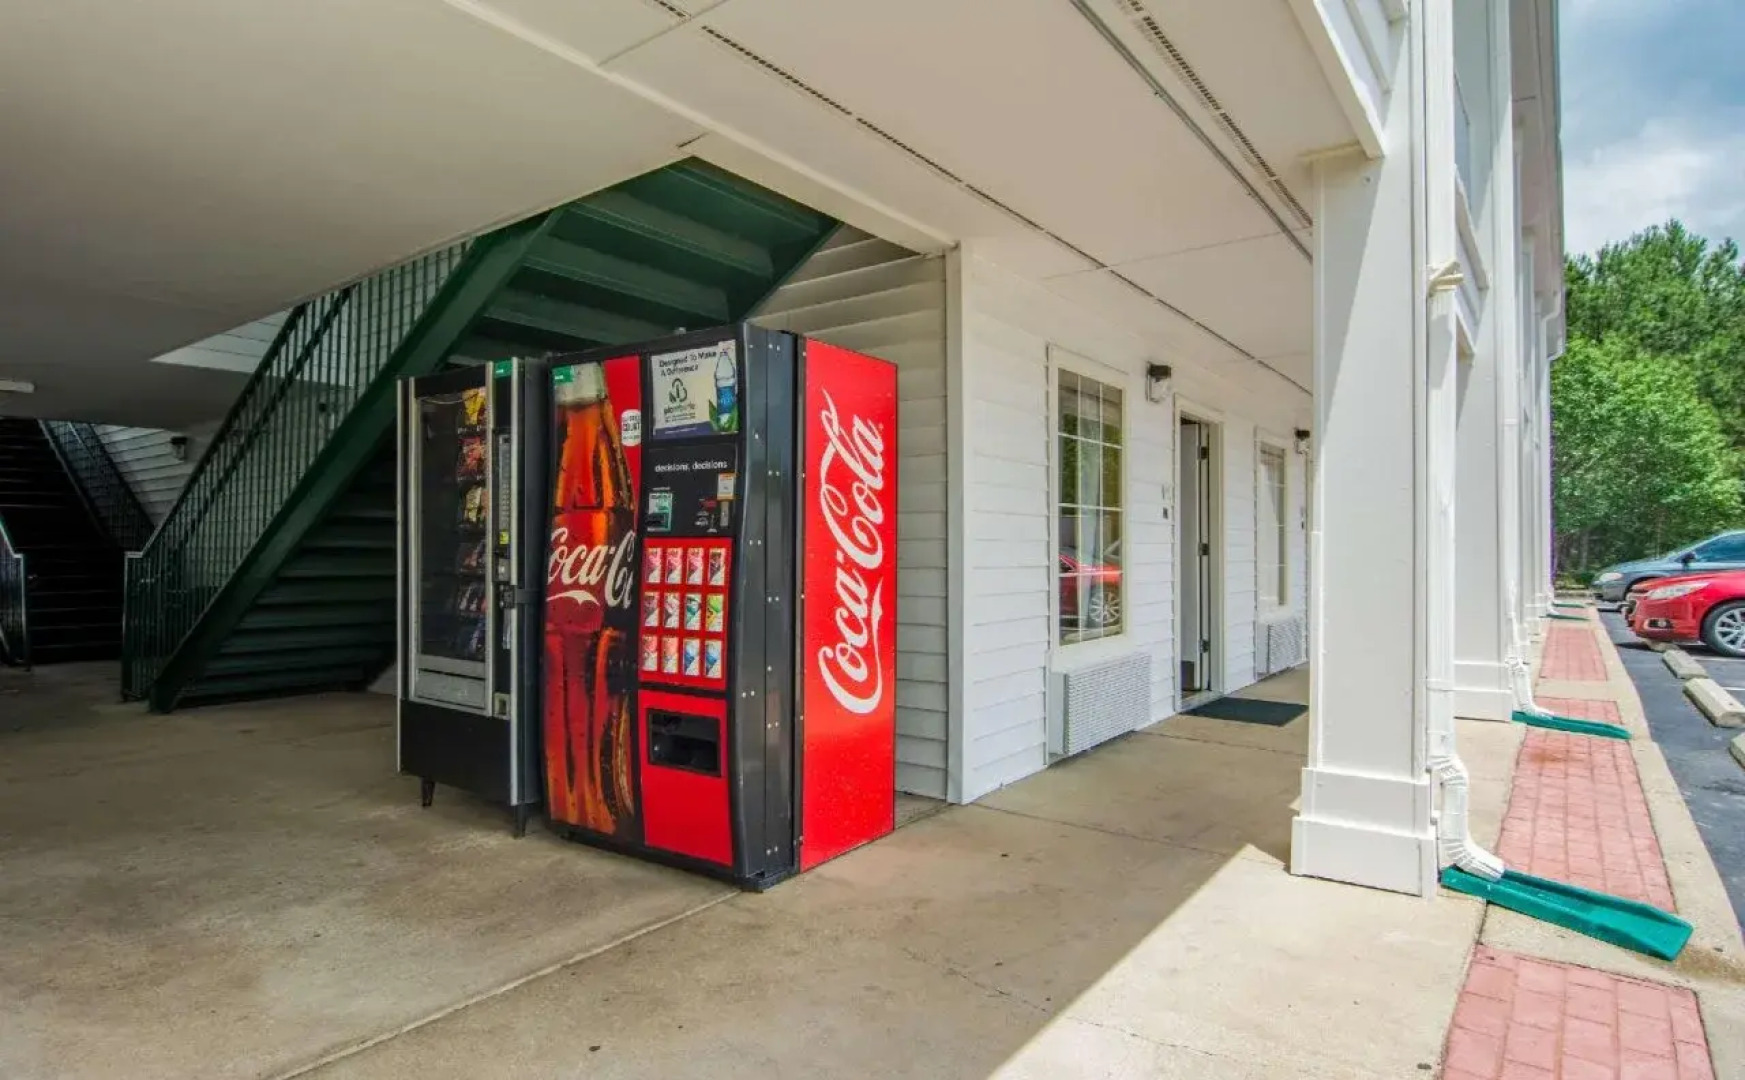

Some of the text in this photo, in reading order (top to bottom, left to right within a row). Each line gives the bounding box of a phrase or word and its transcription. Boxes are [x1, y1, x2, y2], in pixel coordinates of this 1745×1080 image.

[659, 356, 688, 367] Designed
[698, 351, 717, 360] Make
[667, 364, 698, 375] Difference
[692, 460, 728, 470] decisions
[818, 388, 885, 714] Coca-Cola
